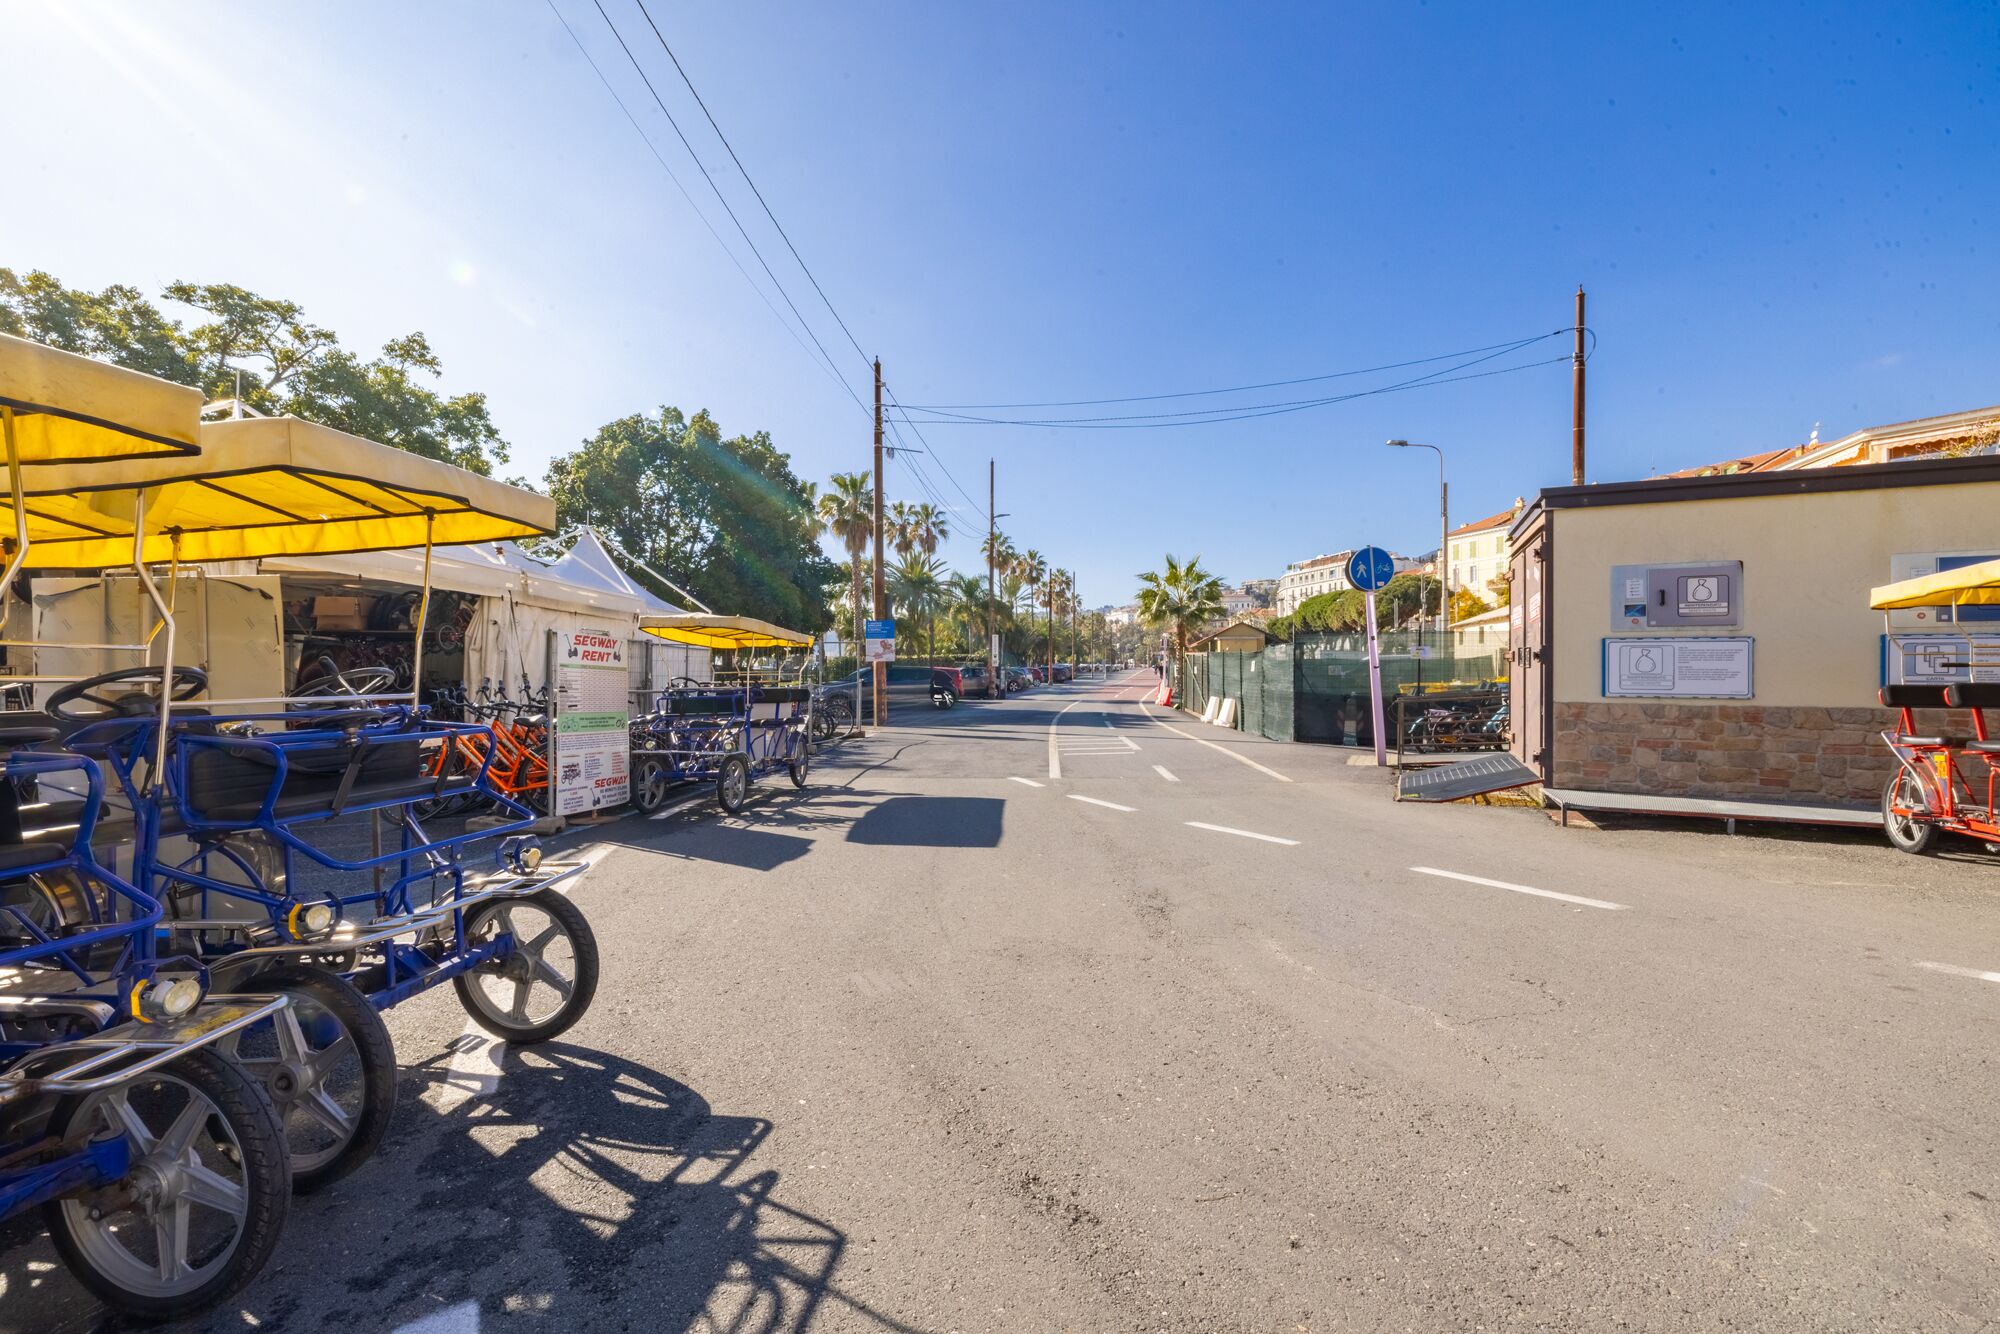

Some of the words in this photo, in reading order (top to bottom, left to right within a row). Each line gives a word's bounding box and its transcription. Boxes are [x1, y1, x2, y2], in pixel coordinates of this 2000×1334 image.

[574, 634, 618, 649] SEGWAY
[581, 650, 612, 662] RENT
[594, 776, 629, 788] SEGWAY
